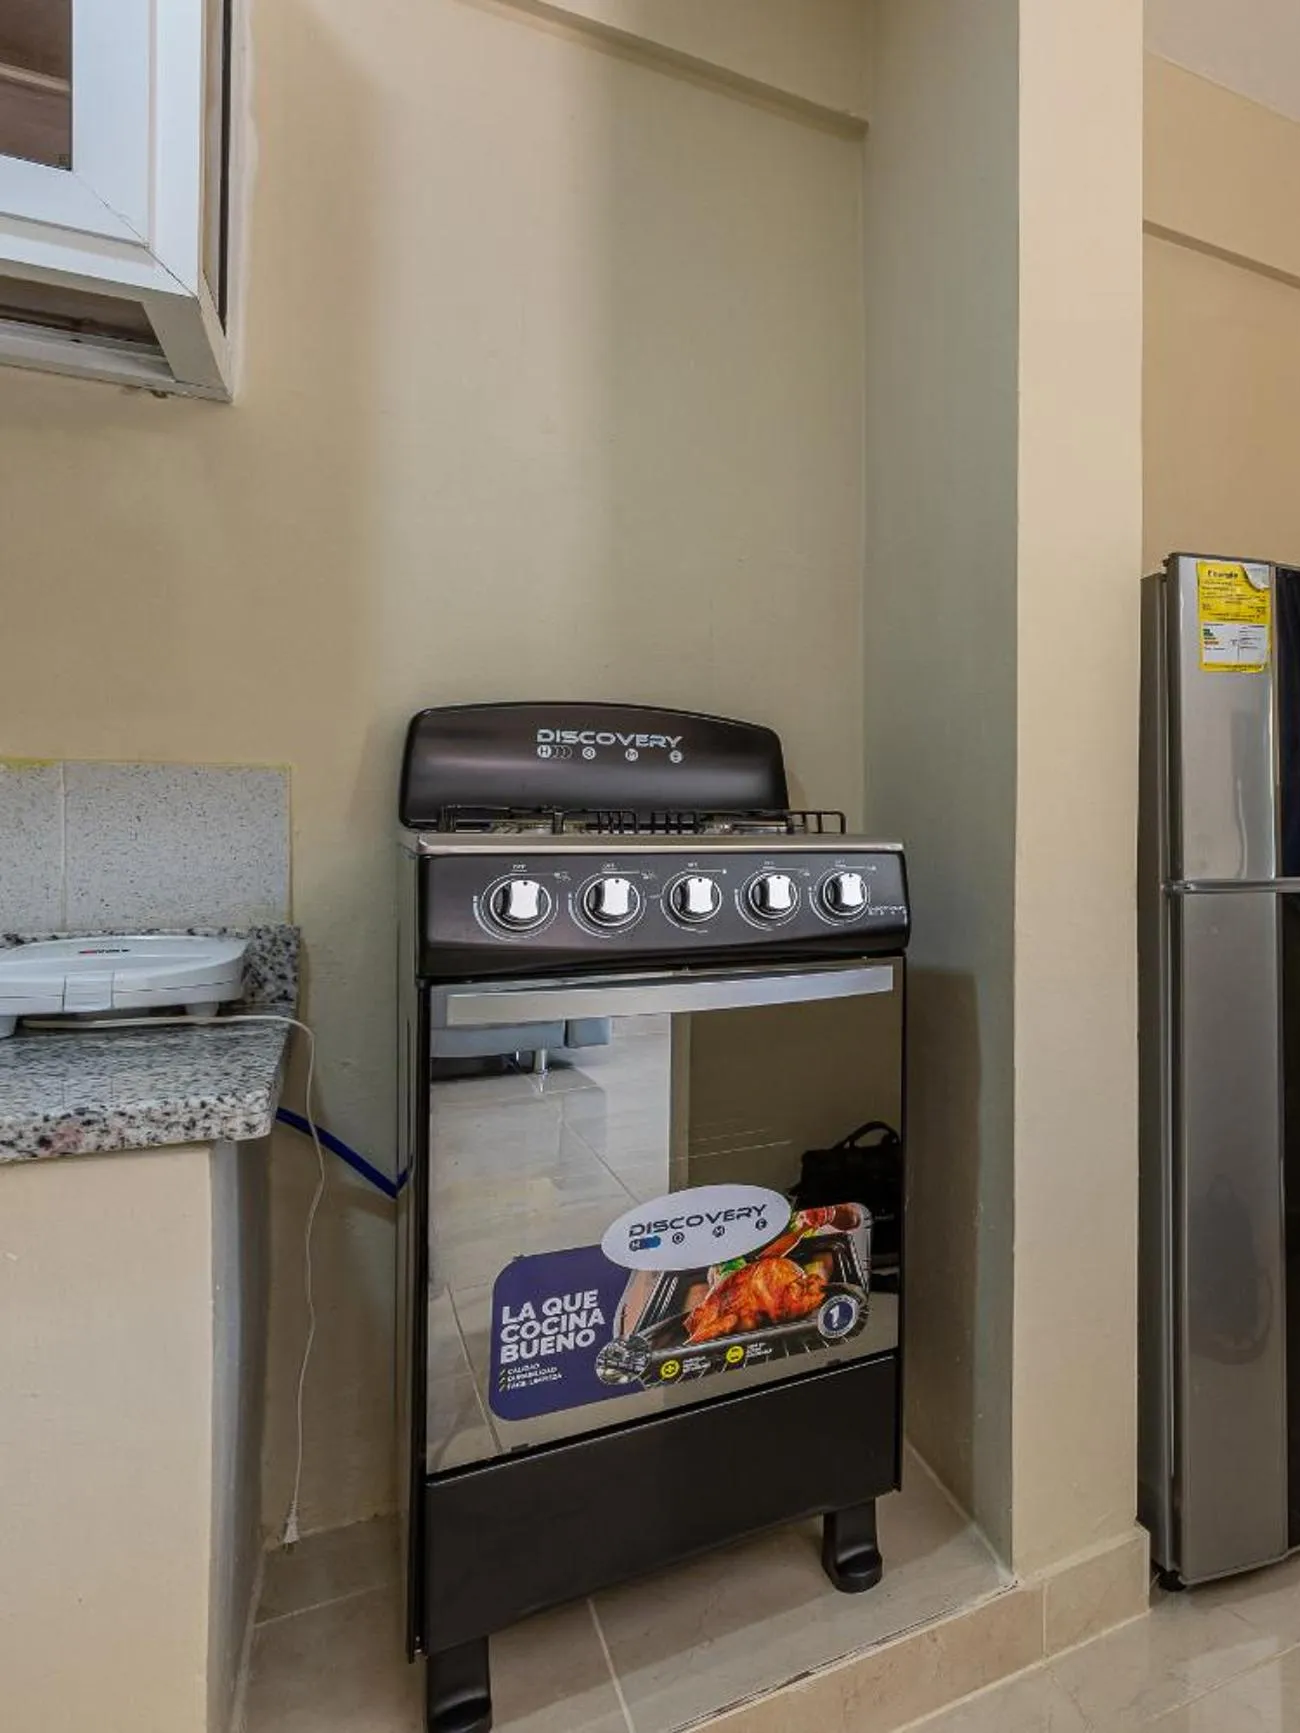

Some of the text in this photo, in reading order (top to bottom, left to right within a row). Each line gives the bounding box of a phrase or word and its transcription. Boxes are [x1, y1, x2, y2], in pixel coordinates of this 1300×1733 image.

[536, 728, 683, 748] DISCOVERY
[629, 1204, 767, 1238] DISCOVERY
[502, 1289, 599, 1325] LA QUE
[829, 1305, 840, 1328] 1
[500, 1308, 605, 1344] COCINA
[500, 1328, 596, 1364] BUENO
